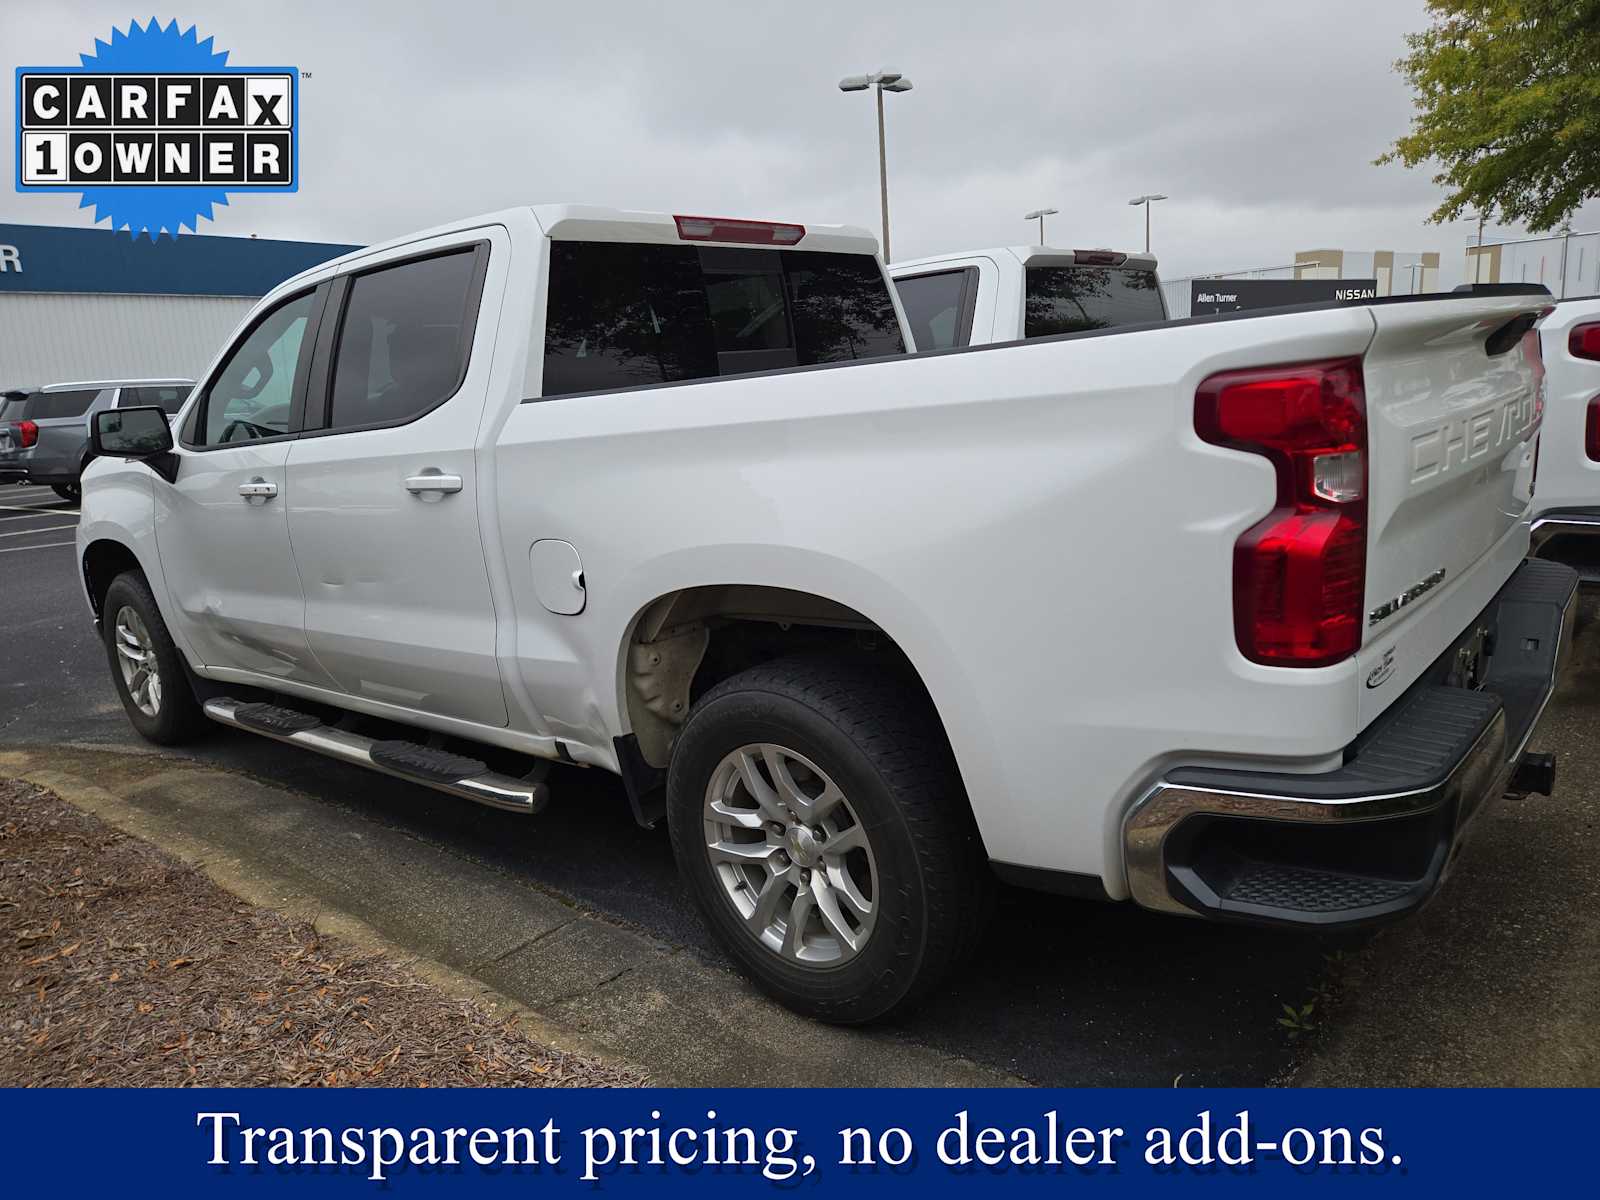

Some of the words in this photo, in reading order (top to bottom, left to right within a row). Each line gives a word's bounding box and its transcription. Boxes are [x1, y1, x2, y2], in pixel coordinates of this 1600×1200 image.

[1197, 293, 1215, 303] Allen
[1215, 293, 1237, 302] Turner
[1335, 289, 1375, 300] NISSAN
